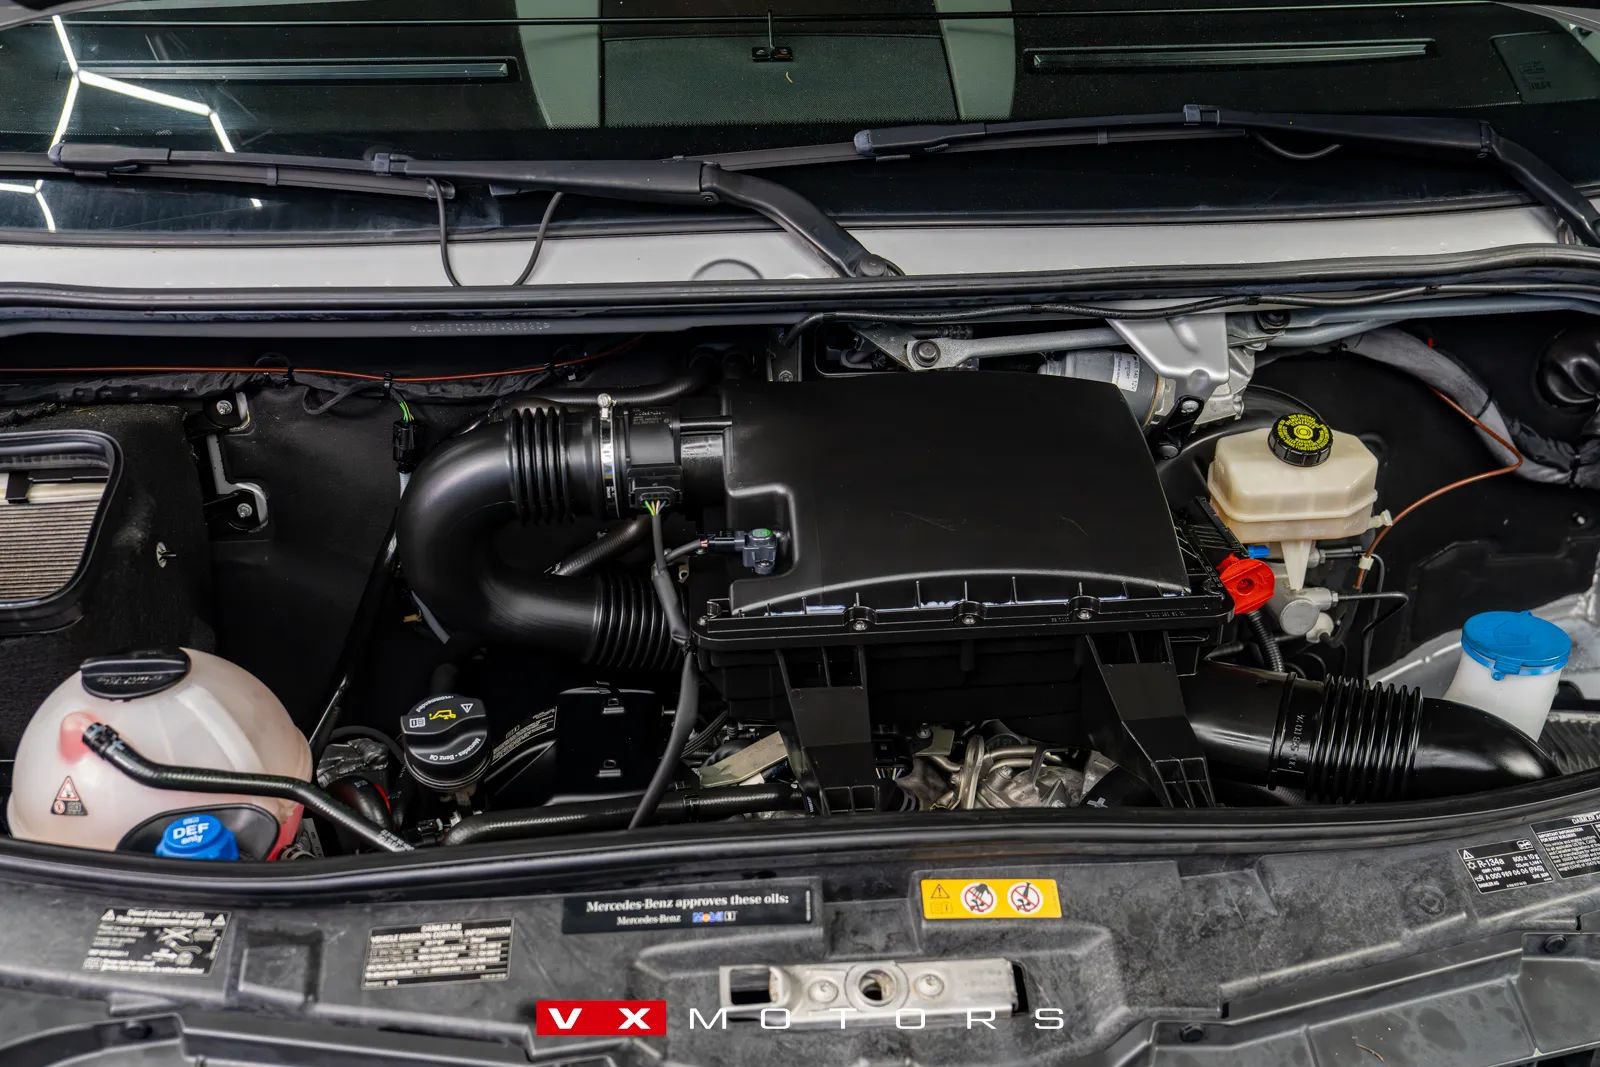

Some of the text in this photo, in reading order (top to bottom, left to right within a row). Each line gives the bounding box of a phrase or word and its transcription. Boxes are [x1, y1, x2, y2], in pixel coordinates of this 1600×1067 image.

[458, 738, 481, 760] Mercedes
[172, 822, 210, 840] DEF
[1477, 857, 1505, 868] R-134a
[1490, 872, 1502, 880] 000
[1528, 865, 1545, 874] (PAG)
[586, 893, 790, 913] Mercedes-Benz approves these oils:
[616, 914, 682, 926] Mercedes-Benz
[432, 930, 464, 940] CONTROL
[464, 926, 512, 938] INFORMATION
